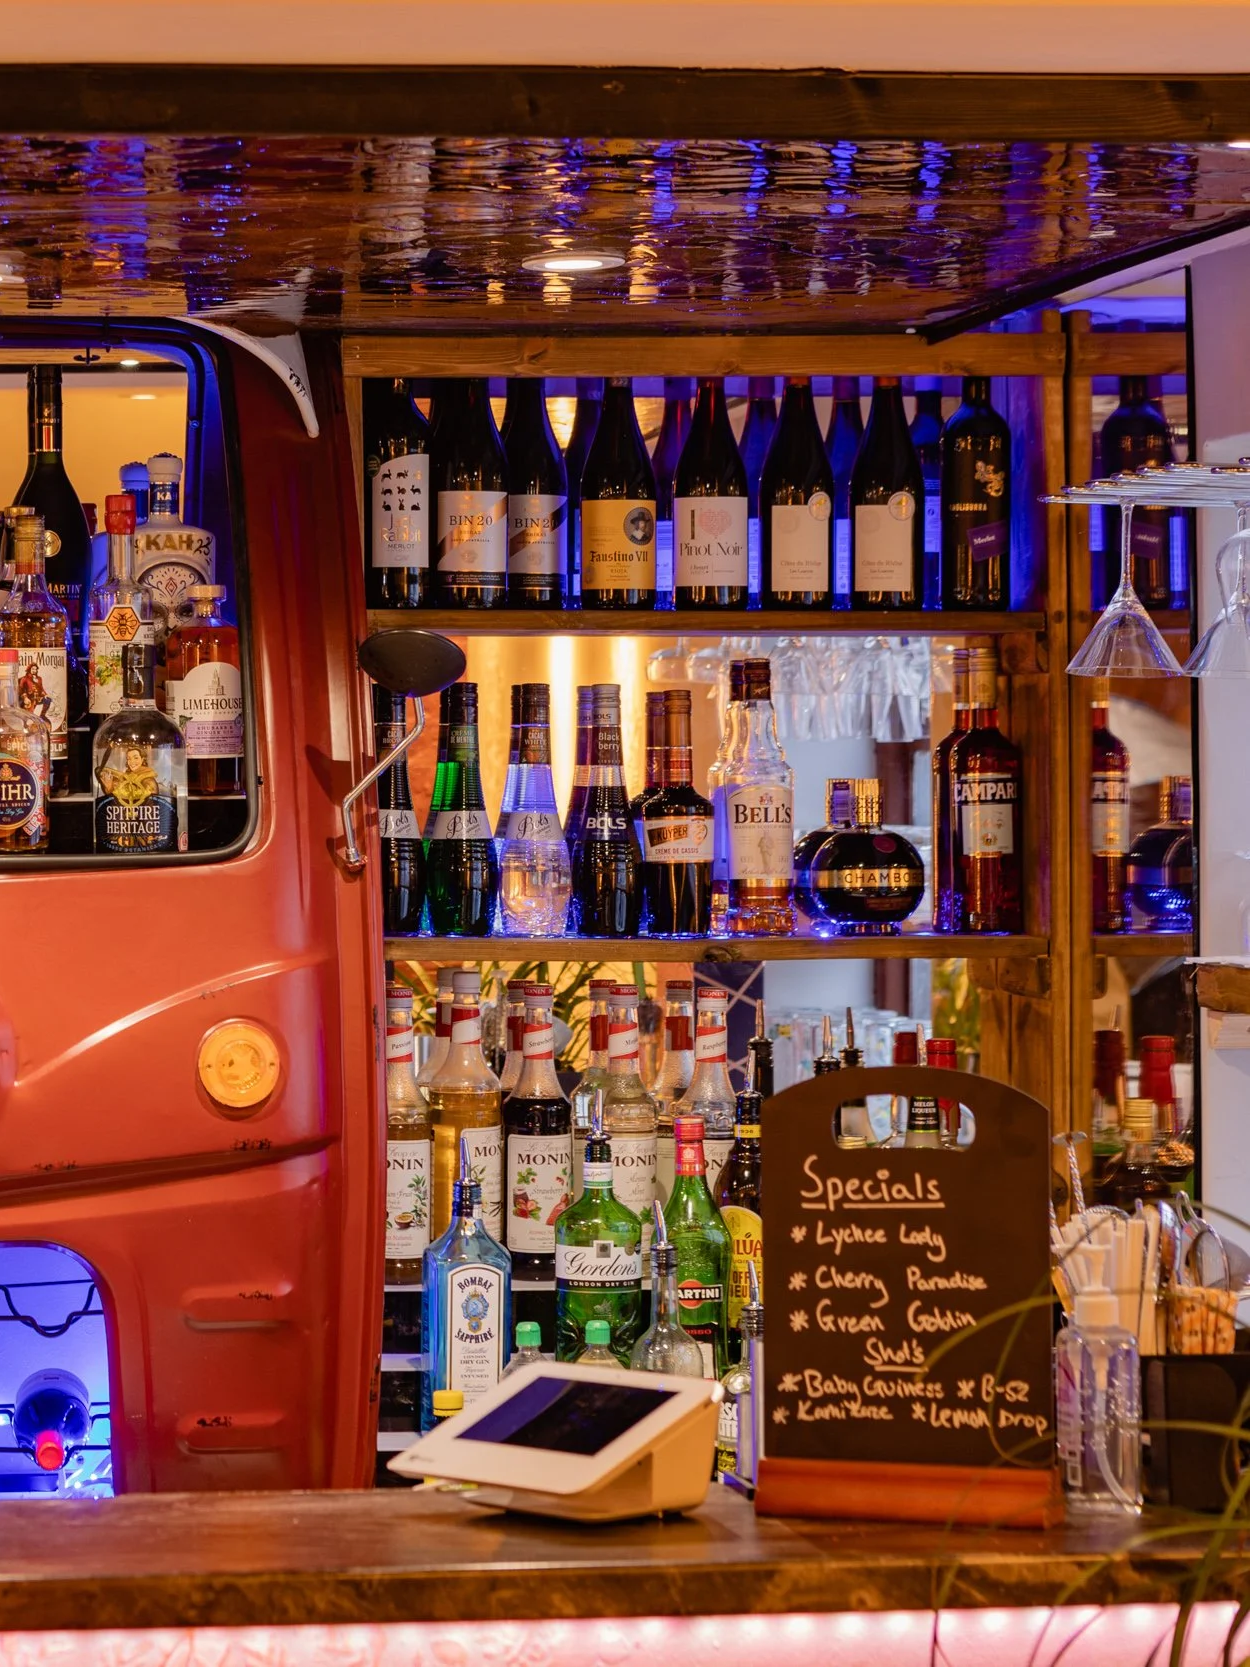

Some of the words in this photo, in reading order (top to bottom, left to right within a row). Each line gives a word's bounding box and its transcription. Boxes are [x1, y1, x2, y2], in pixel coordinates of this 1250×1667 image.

[449, 515, 474, 526] BIN
[477, 515, 493, 525] 20
[514, 518, 540, 529] BIN
[145, 533, 194, 551] KAH
[679, 543, 712, 557] Pinot
[716, 542, 744, 556] Noir
[590, 551, 634, 562] Faustino
[637, 551, 648, 562] VII
[38, 652, 65, 668] Morgan
[598, 732, 620, 741] Black
[598, 742, 620, 753] berry
[954, 782, 1017, 801] CAMPARI
[106, 805, 161, 820] SPITFIRE
[734, 804, 791, 824] BELL'S
[106, 821, 161, 834] HERITAGE
[586, 818, 627, 829] BOLS
[657, 826, 688, 842] KUYPER
[517, 1153, 571, 1165] MONIN
[800, 1154, 942, 1211] Specials
[816, 1220, 887, 1255] Lychee
[900, 1223, 947, 1262] Lady
[564, 1251, 637, 1276] Gordon's
[457, 1276, 494, 1293] BOMBAY
[815, 1265, 889, 1308] Cherry
[906, 1265, 988, 1291] Paradise
[816, 1298, 885, 1333] Green
[907, 1300, 976, 1333] Goblin
[454, 1328, 495, 1344] SAPPHIRE
[805, 1369, 861, 1405] Baby
[982, 1374, 1030, 1402] B-52
[930, 1403, 989, 1428] Lemon
[998, 1411, 1048, 1437] Drop
